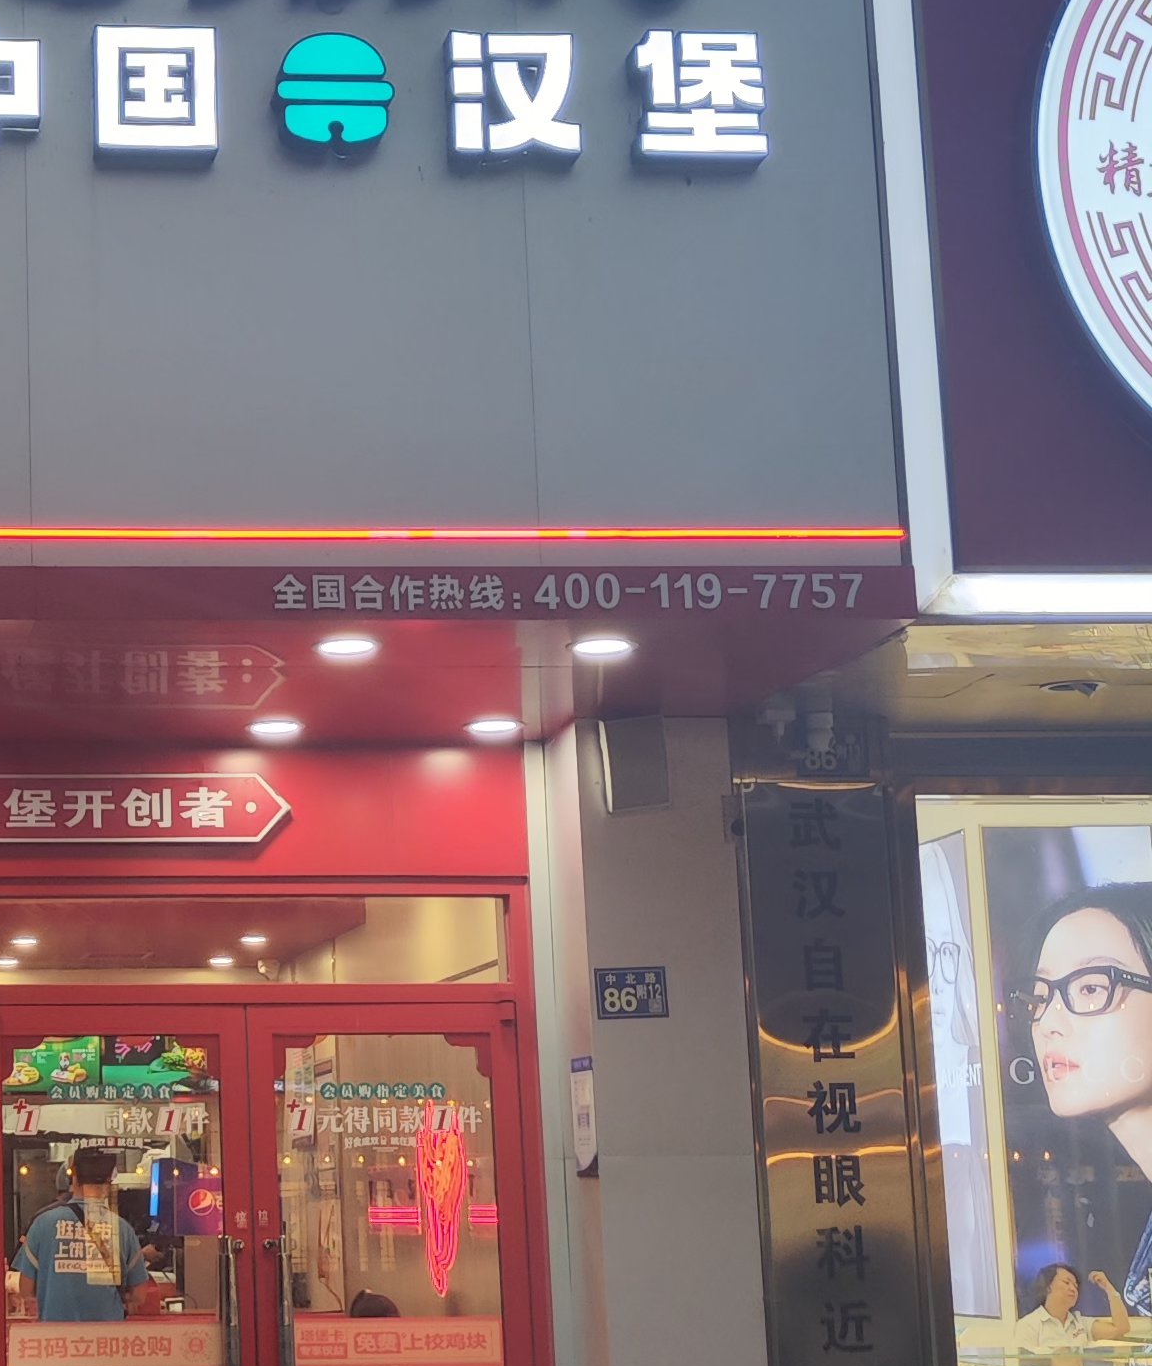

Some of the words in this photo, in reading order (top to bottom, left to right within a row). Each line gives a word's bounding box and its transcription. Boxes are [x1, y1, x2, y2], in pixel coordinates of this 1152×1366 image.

[448, 29, 771, 170] 汉堡
[1097, 138, 1152, 197] 精
[605, 971, 656, 985] 中北路
[604, 987, 637, 1012] 86
[49, 1086, 172, 1099] 会员购指定美食
[323, 1085, 444, 1098] 会员购指定美食
[18, 1336, 172, 1359] 扫码立即抢购
[356, 1333, 398, 1352] 免费
[404, 1333, 487, 1350] 上校鸡块
